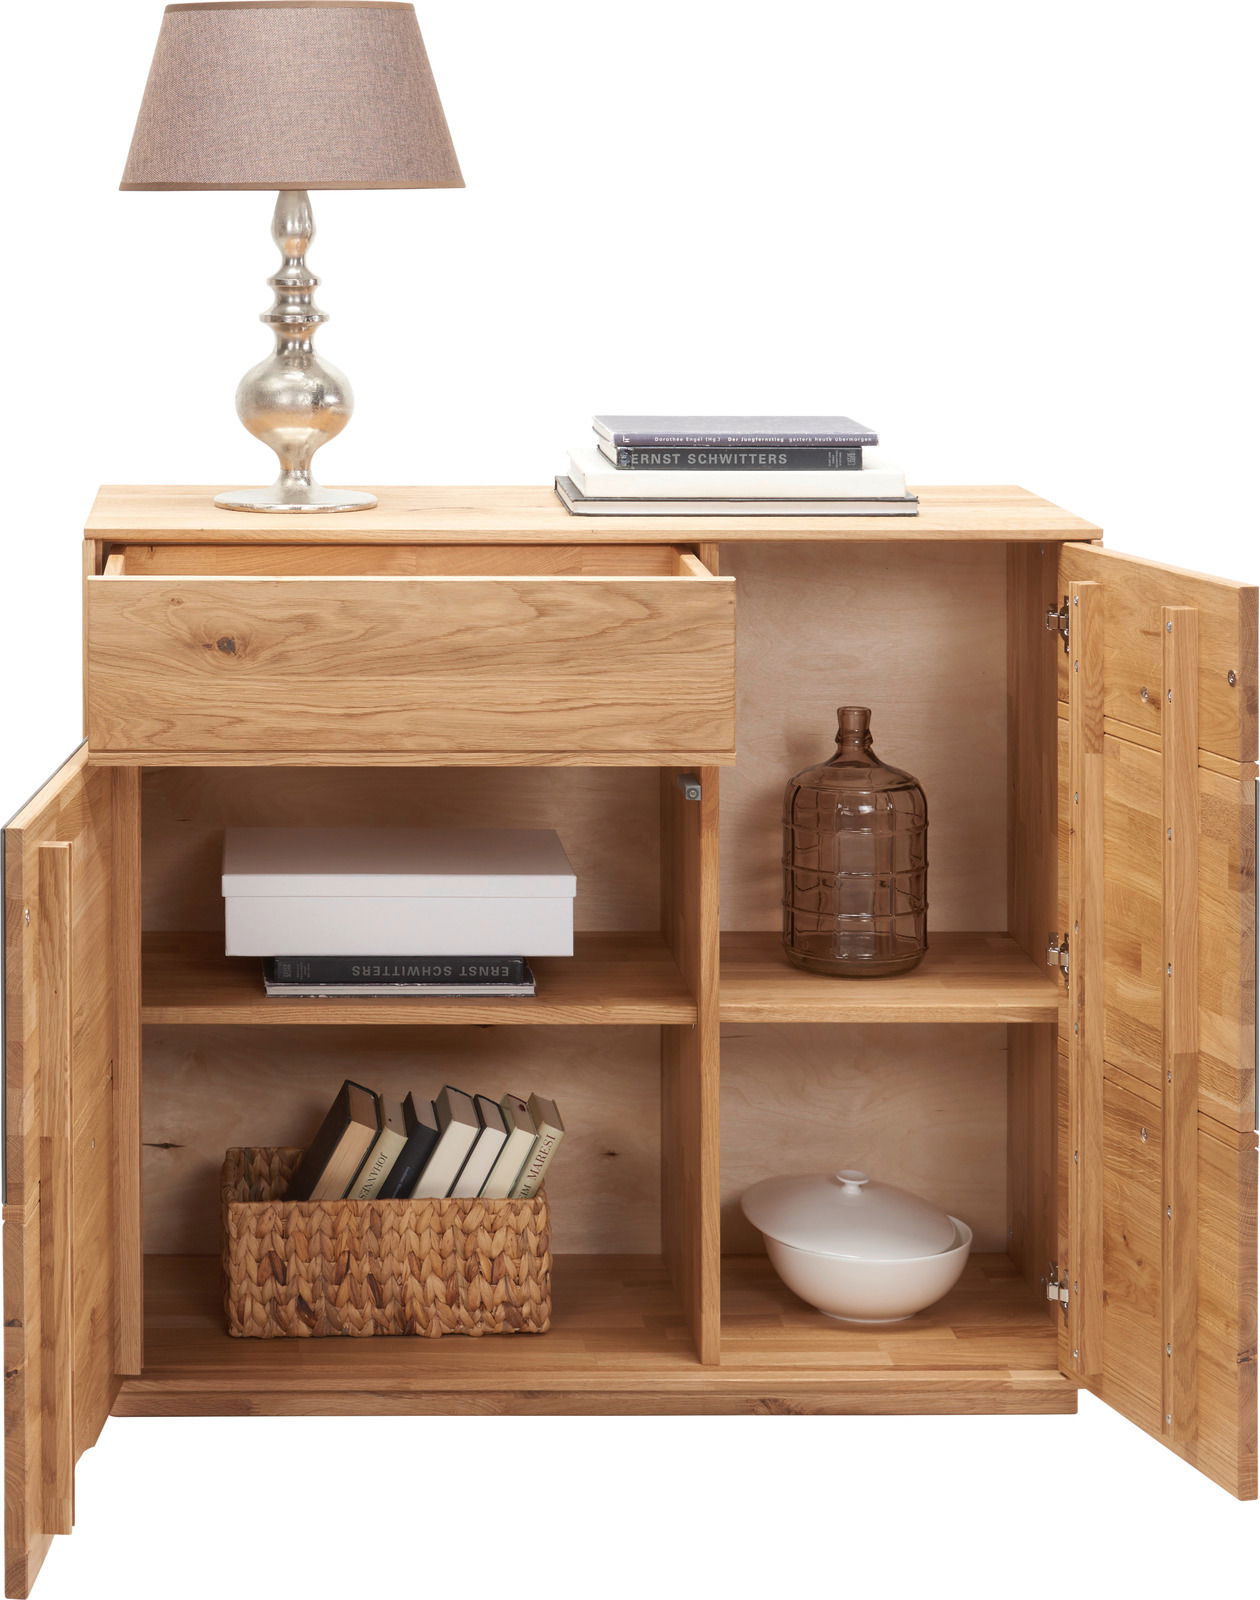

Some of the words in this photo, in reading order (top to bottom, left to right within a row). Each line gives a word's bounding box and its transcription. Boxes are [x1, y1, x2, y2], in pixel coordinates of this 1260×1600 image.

[631, 453, 680, 465] ERNST
[687, 453, 788, 465] SCHWITTERS
[351, 965, 452, 977] SCHWITTERS
[460, 966, 509, 977] ERNST
[527, 1133, 556, 1181] MARESI
[360, 1151, 388, 1200] JOHANNES
